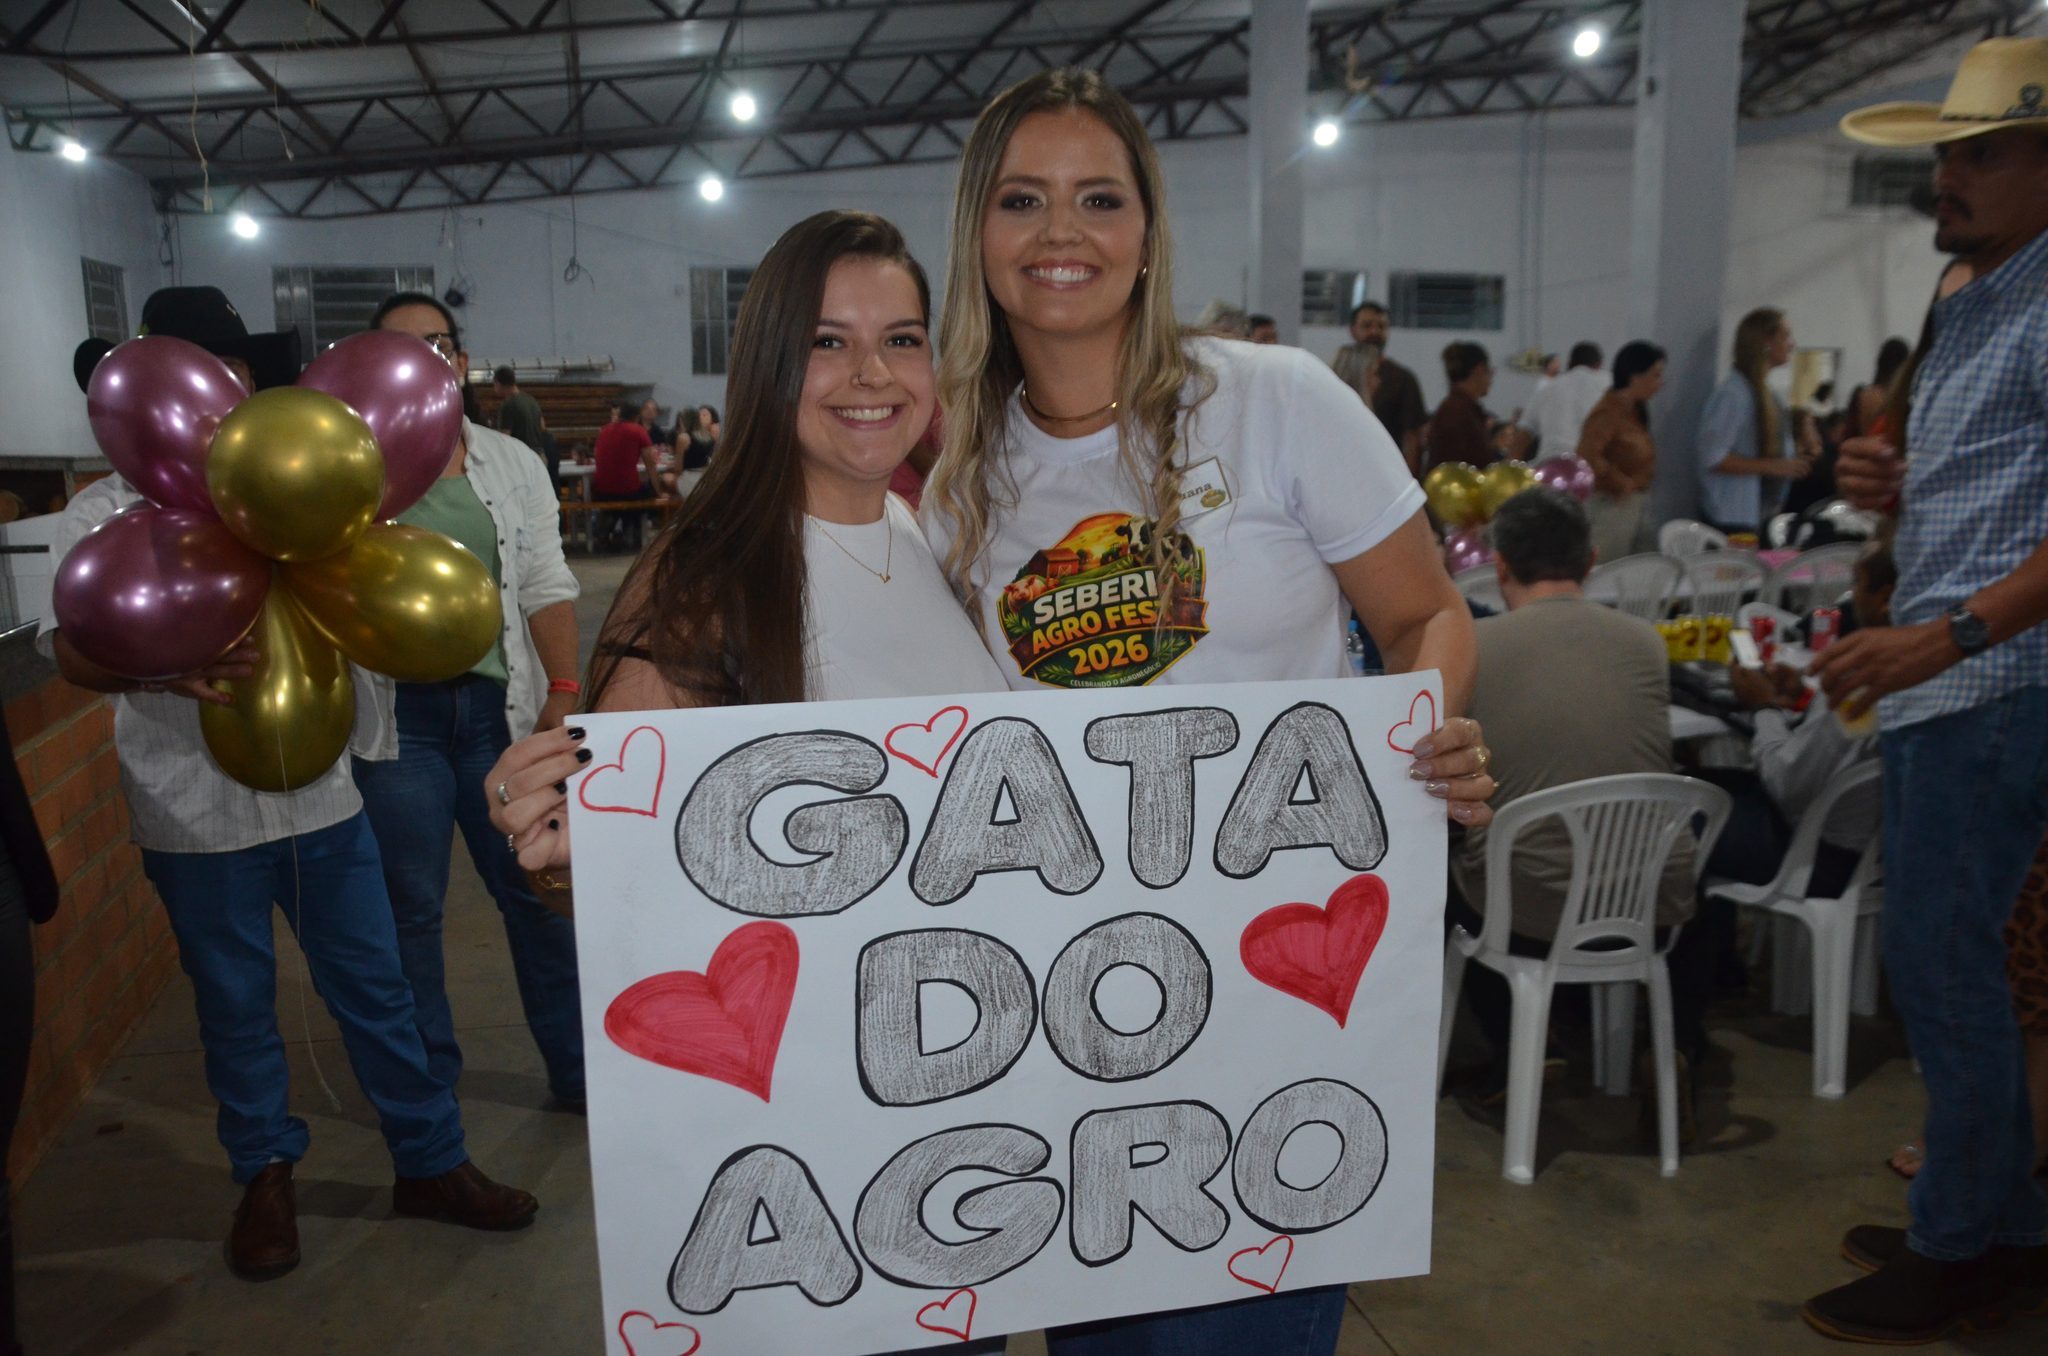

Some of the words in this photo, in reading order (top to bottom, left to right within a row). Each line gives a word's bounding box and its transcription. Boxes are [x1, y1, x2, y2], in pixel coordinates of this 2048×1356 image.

[1033, 570, 1158, 625] SEBERI
[1032, 611, 1102, 655] AGRO
[1105, 599, 1163, 630] FES
[1068, 634, 1150, 676] 2026
[1070, 679, 1112, 688] CELEBRANDO
[675, 701, 1389, 918] GATA
[855, 911, 1213, 1107] DO
[667, 1078, 1389, 1315] AGRO
